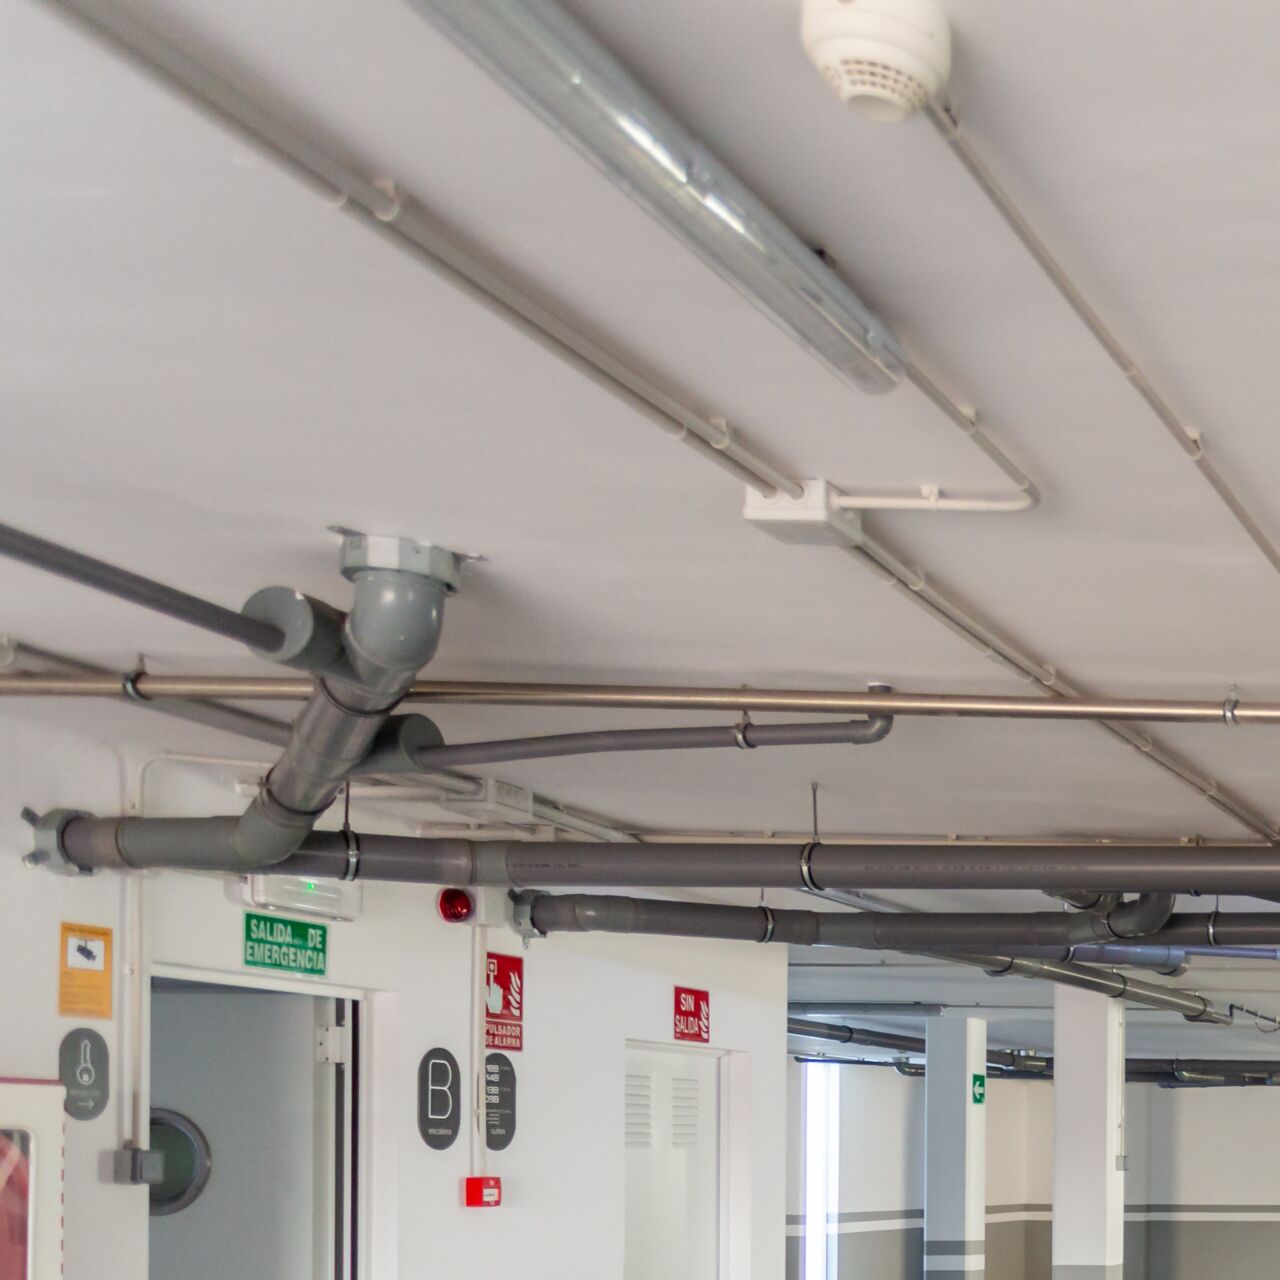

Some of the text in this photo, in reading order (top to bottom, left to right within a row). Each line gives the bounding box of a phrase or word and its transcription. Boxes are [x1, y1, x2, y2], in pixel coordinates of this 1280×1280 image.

[250, 918, 323, 949] SALIDA DE
[245, 941, 325, 971] EMERGENCIA
[680, 993, 695, 1012] SIN
[485, 1023, 521, 1038] PULSADOR
[675, 1014, 699, 1035] SALIDA
[494, 1036, 521, 1048] ALARMA
[428, 1059, 452, 1119] B
